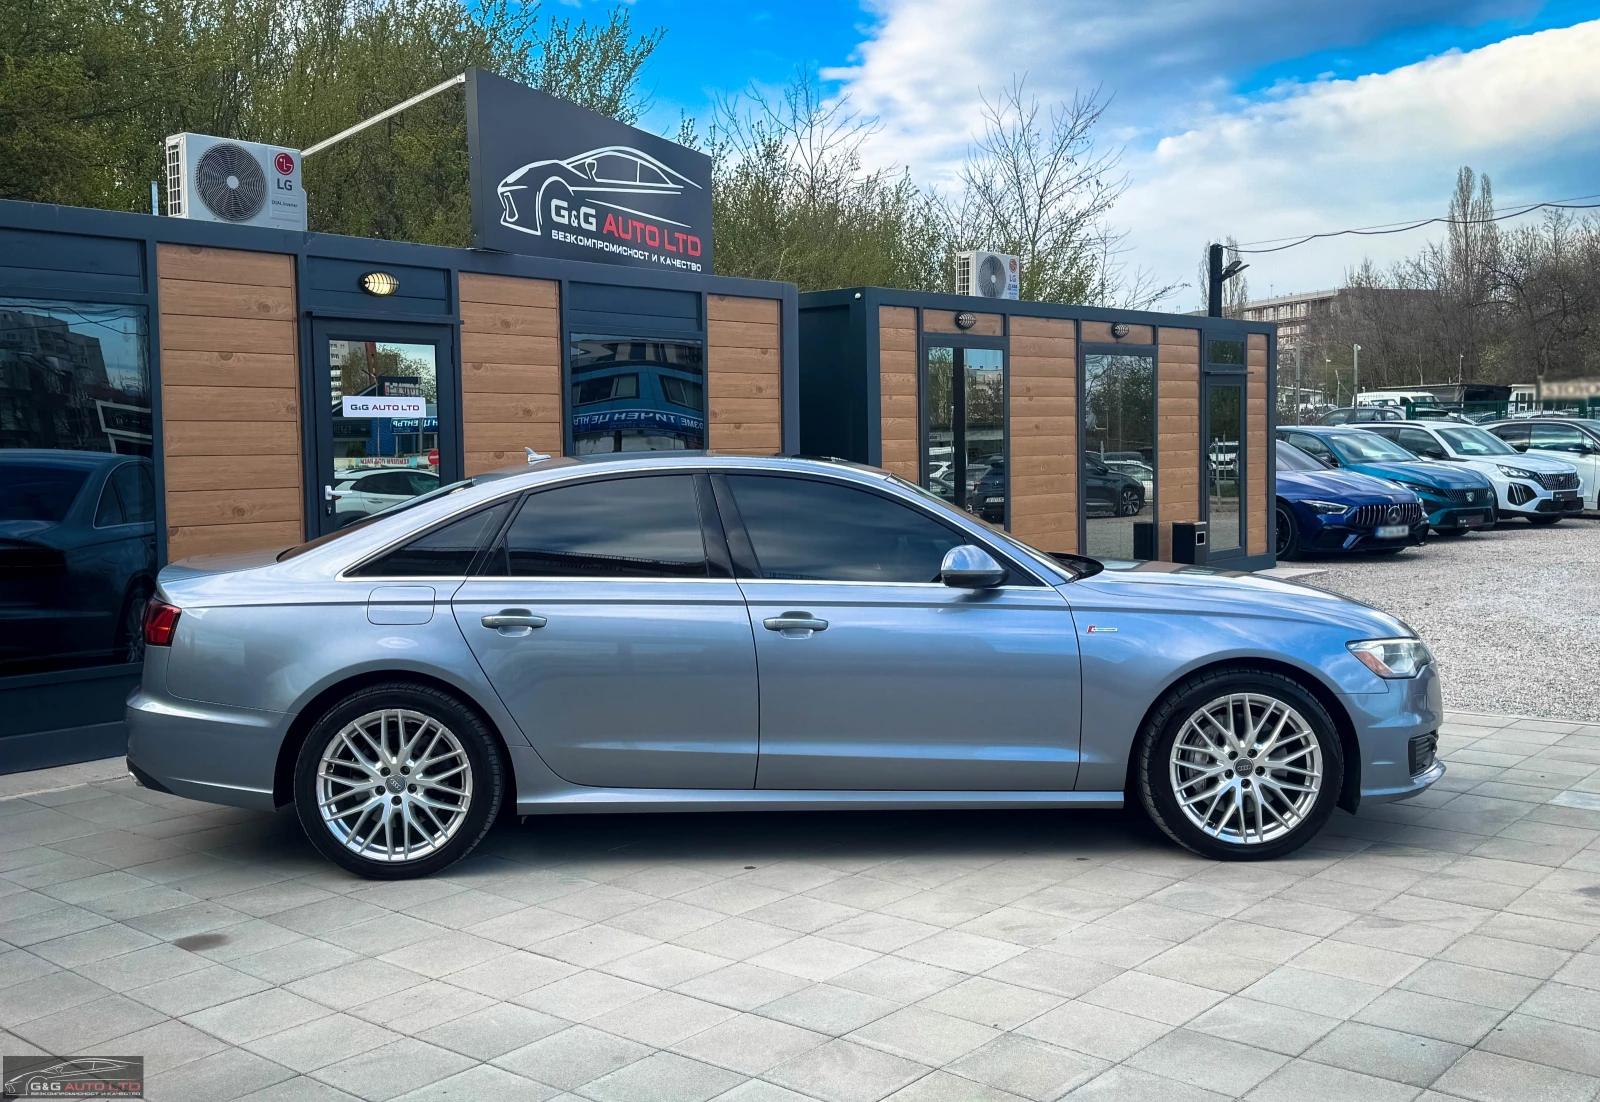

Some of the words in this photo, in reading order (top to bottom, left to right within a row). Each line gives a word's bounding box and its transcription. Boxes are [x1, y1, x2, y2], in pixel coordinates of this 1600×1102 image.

[276, 178, 293, 191] LG
[550, 198, 597, 232] G&G
[602, 213, 660, 248] AUTO
[664, 229, 702, 257] LTD
[551, 229, 649, 261] БЕЗКОМПРОМИСНОСТ
[651, 253, 658, 263] И
[660, 255, 702, 272] КАЧЕСТВО
[1008, 274, 1017, 283] LG
